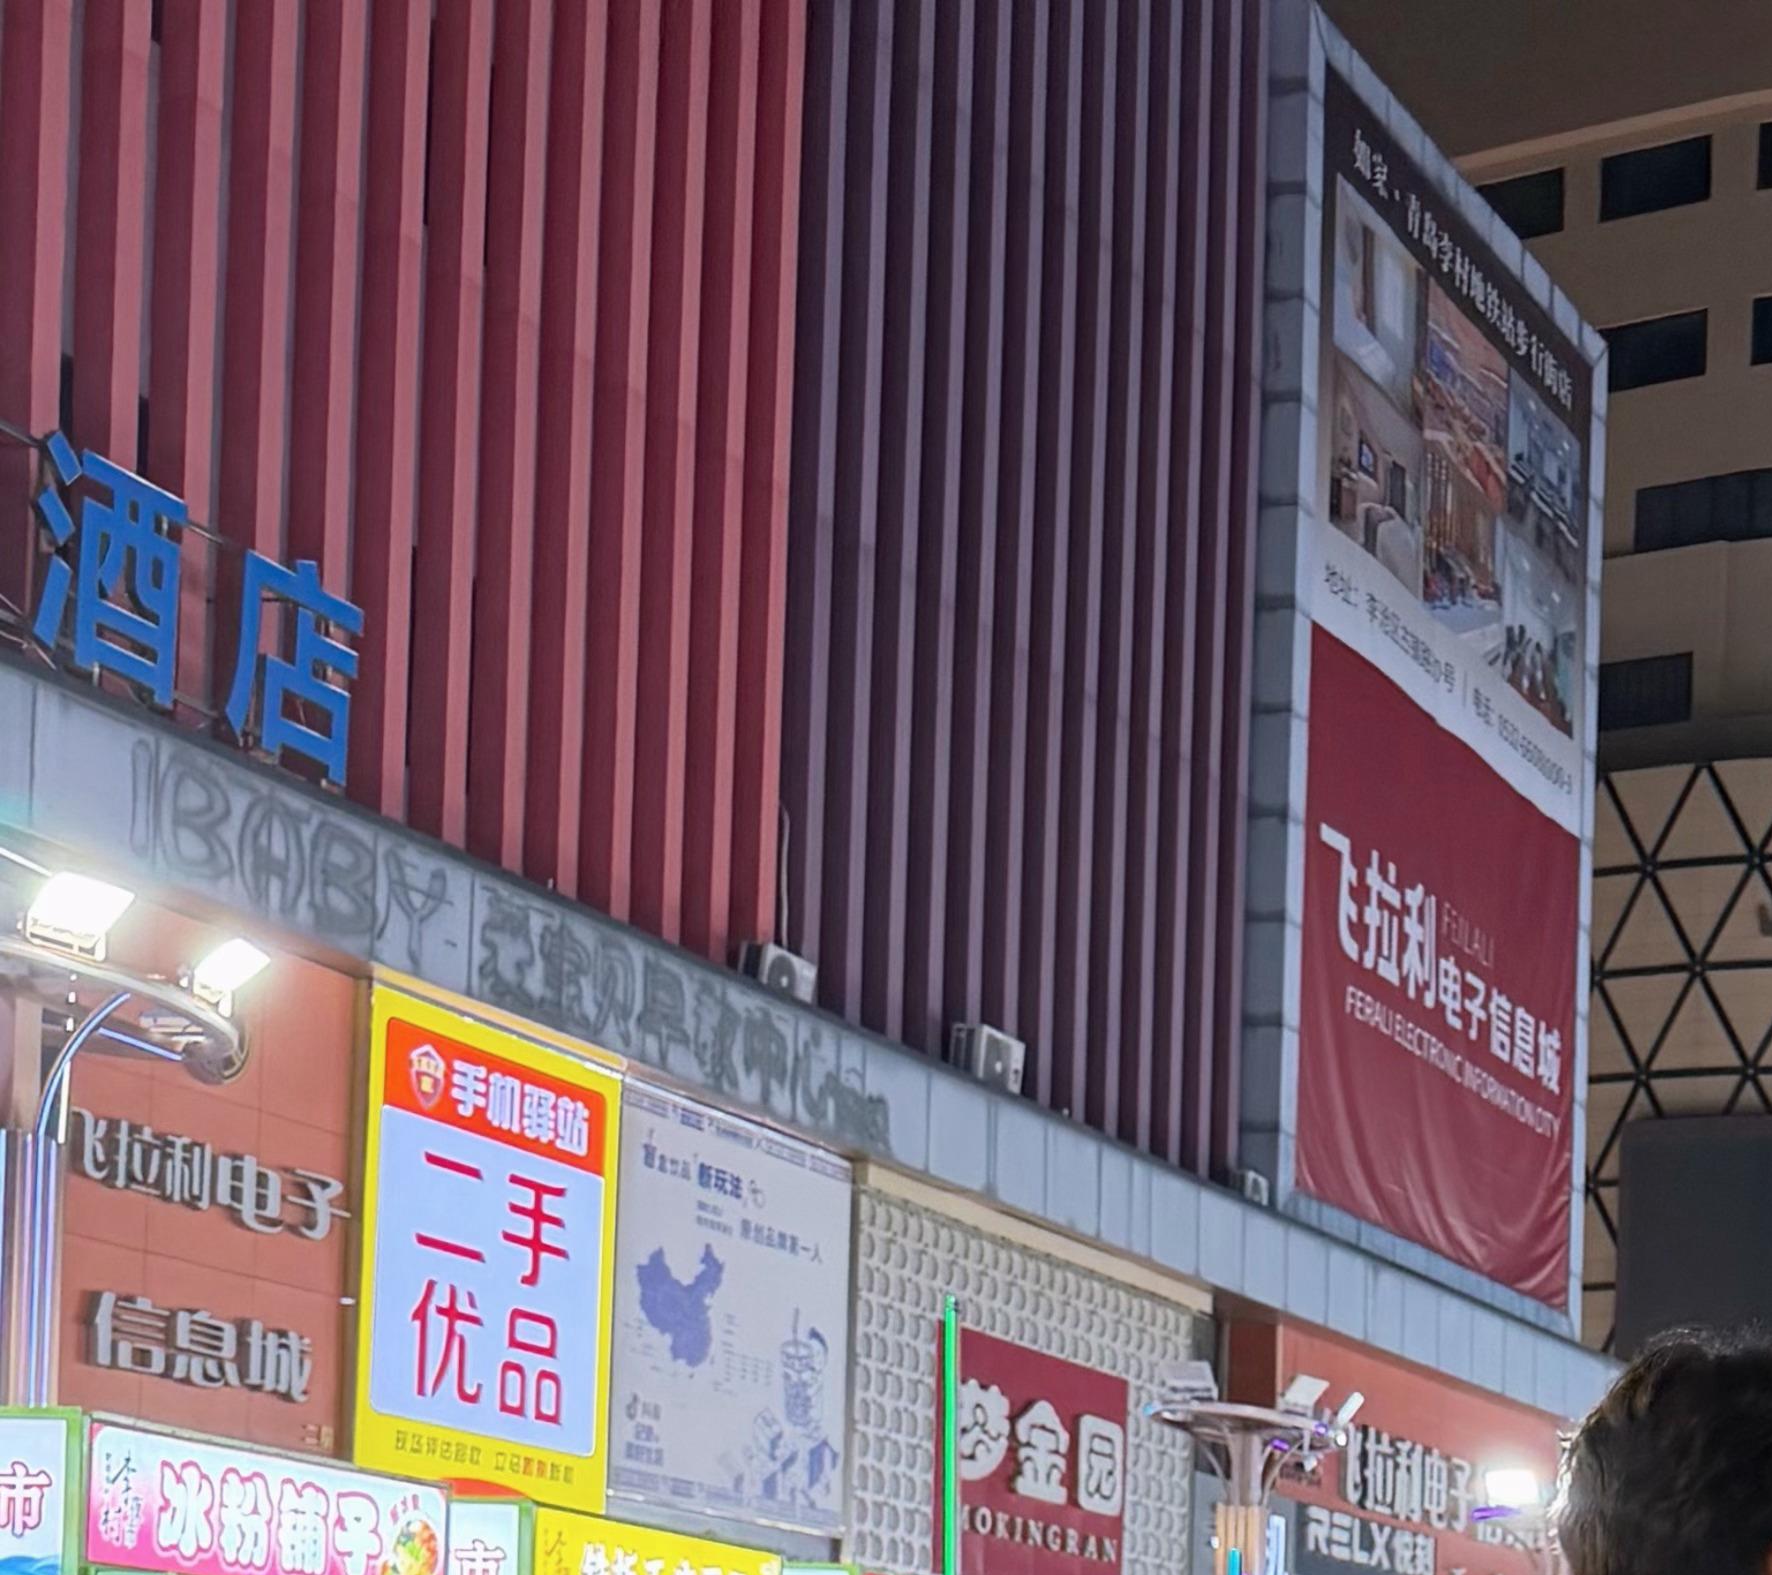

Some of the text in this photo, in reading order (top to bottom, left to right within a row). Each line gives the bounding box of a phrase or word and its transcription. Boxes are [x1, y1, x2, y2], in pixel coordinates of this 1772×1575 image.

[34, 429, 365, 787] 酒店
[1319, 822, 1562, 1096] 飞拉利电子信息城
[71, 1106, 351, 1241] 飞拉利电子
[450, 1059, 592, 1159] 手机驿站
[413, 1150, 571, 1287] 二手
[88, 1291, 313, 1402] 信息城
[410, 1278, 564, 1427] 优品
[1305, 1505, 1391, 1571] RELX
